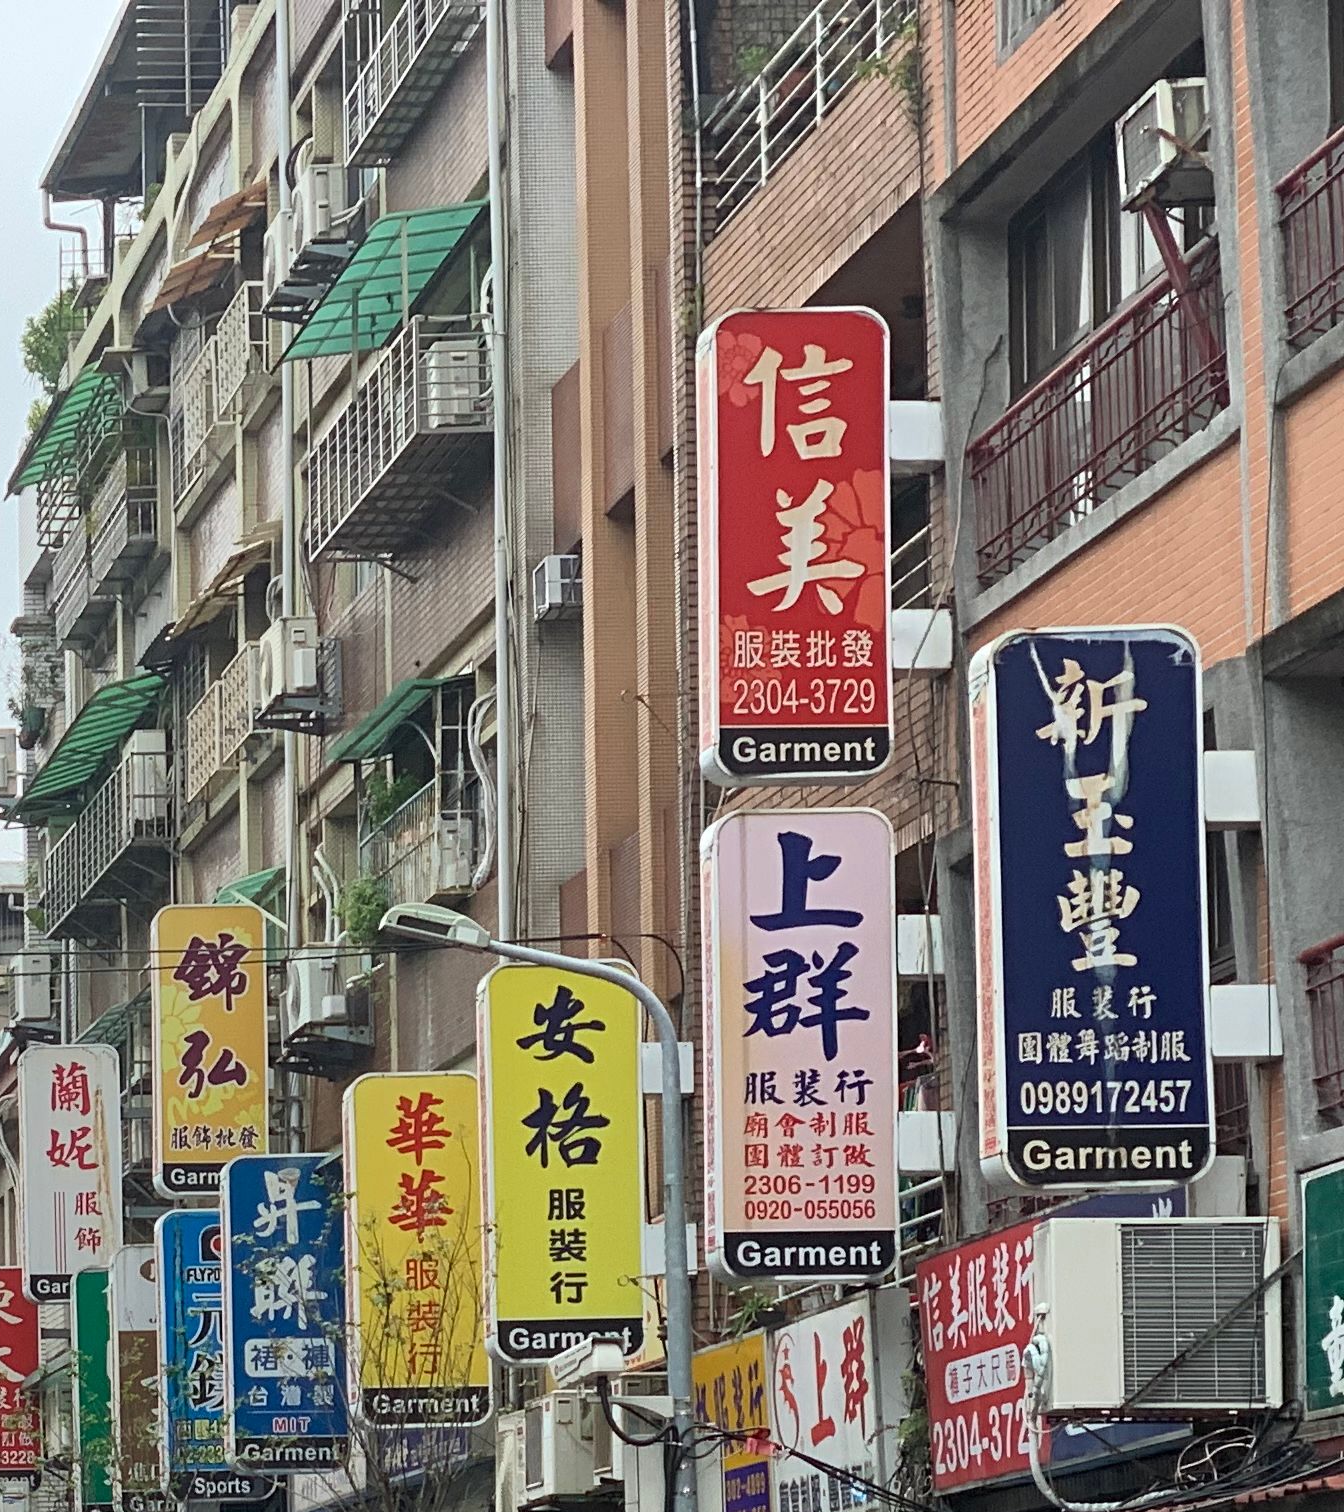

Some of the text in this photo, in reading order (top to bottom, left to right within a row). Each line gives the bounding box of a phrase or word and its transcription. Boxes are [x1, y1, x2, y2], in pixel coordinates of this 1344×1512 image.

[744, 343, 866, 616] 信美
[732, 629, 874, 669] 服裝批發
[732, 678, 877, 717] 2304-3729
[732, 735, 877, 764] Garment
[742, 830, 871, 1062] 上群
[1051, 984, 1159, 1020] 服裝行
[743, 1068, 875, 1107] 服裝行
[1018, 1079, 1193, 1117] 0989172457
[743, 1142, 876, 1169] 團體訂做
[1021, 1138, 1194, 1172] Garment
[743, 1172, 877, 1197] 2306-1199
[743, 1197, 877, 1222] 0920-055056
[735, 1238, 884, 1269] Garment
[372, 1394, 481, 1416] Garment
[272, 1416, 312, 1433] MIT
[932, 1399, 1043, 1478] 2304-372
[243, 1442, 339, 1463] Garment
[194, 1477, 252, 1498] Sports
